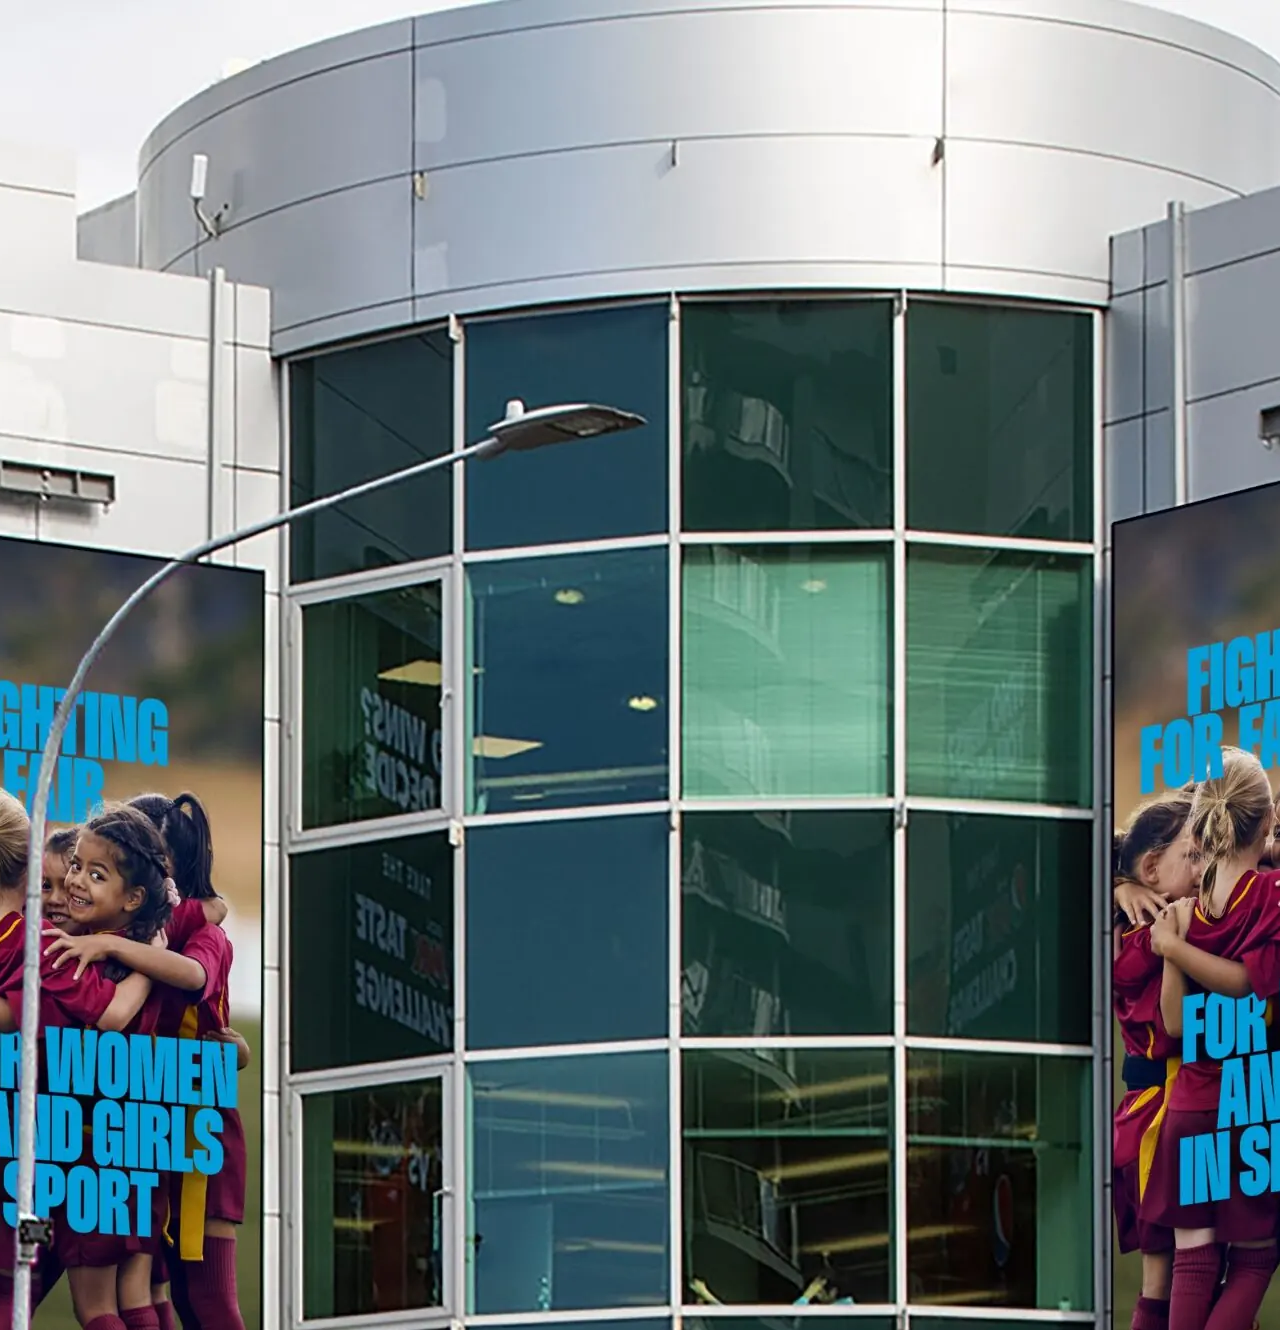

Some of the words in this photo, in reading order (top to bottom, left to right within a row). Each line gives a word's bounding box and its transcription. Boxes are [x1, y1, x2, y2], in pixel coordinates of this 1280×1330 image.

[3, 749, 105, 824] FAIR
[1140, 712, 1224, 796] FOR
[1182, 992, 1267, 1064] FOR
[45, 1026, 238, 1109] WOMEN
[92, 1099, 224, 1176] GIRLS
[1179, 1131, 1231, 1206] IN
